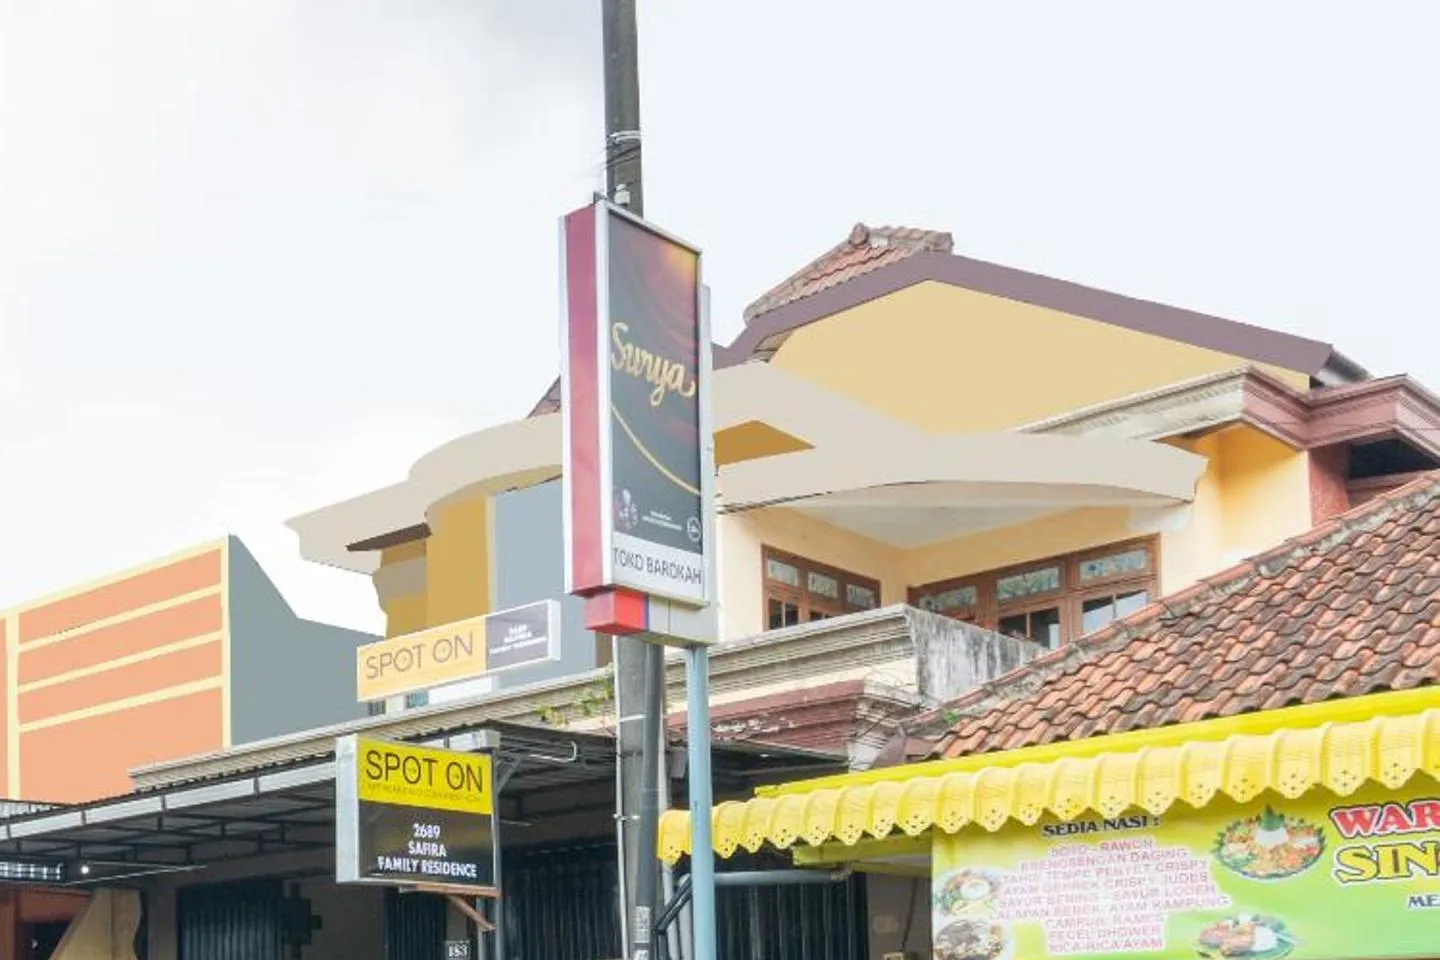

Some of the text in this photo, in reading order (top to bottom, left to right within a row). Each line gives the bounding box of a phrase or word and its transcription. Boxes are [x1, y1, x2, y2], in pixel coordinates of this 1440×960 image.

[610, 322, 695, 406] Surya
[613, 547, 703, 585] TOKO BAROKAH
[365, 645, 425, 681] SPOT
[432, 631, 474, 663] ON
[365, 749, 438, 786] SPOT
[446, 761, 483, 794] ON
[1043, 821, 1099, 837] SEDIA
[1103, 815, 1148, 831] NASI
[377, 855, 478, 879] FAMILY RESIDENCE
